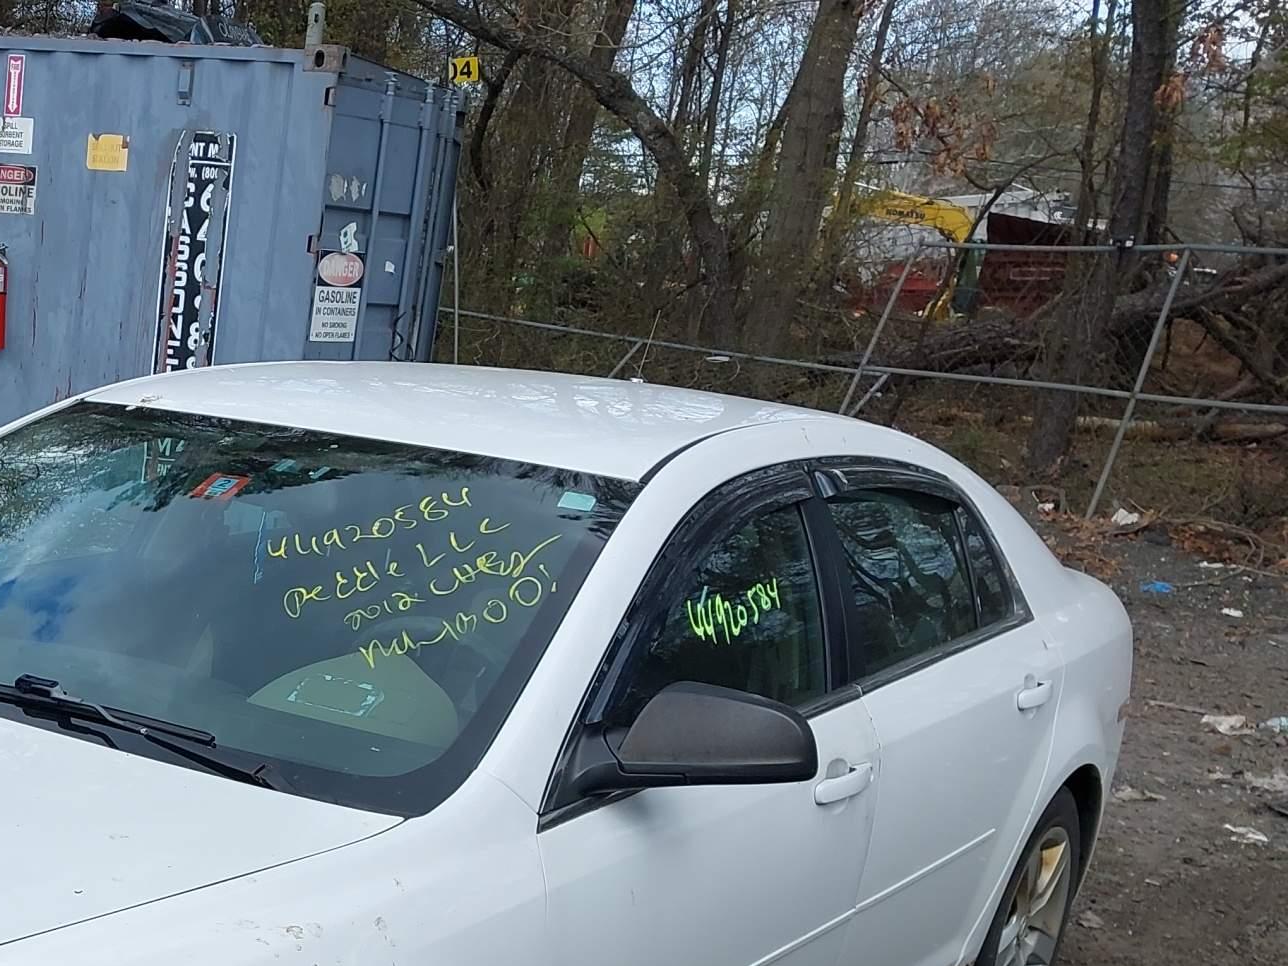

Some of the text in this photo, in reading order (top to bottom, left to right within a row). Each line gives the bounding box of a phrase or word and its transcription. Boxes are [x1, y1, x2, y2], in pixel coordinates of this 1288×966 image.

[0, 140, 24, 148] STORAGE
[318, 289, 358, 304] GASOLINE
[315, 306, 356, 317] IN CONTAINERS
[267, 487, 472, 559] 44920584
[687, 577, 781, 645] 44920584
